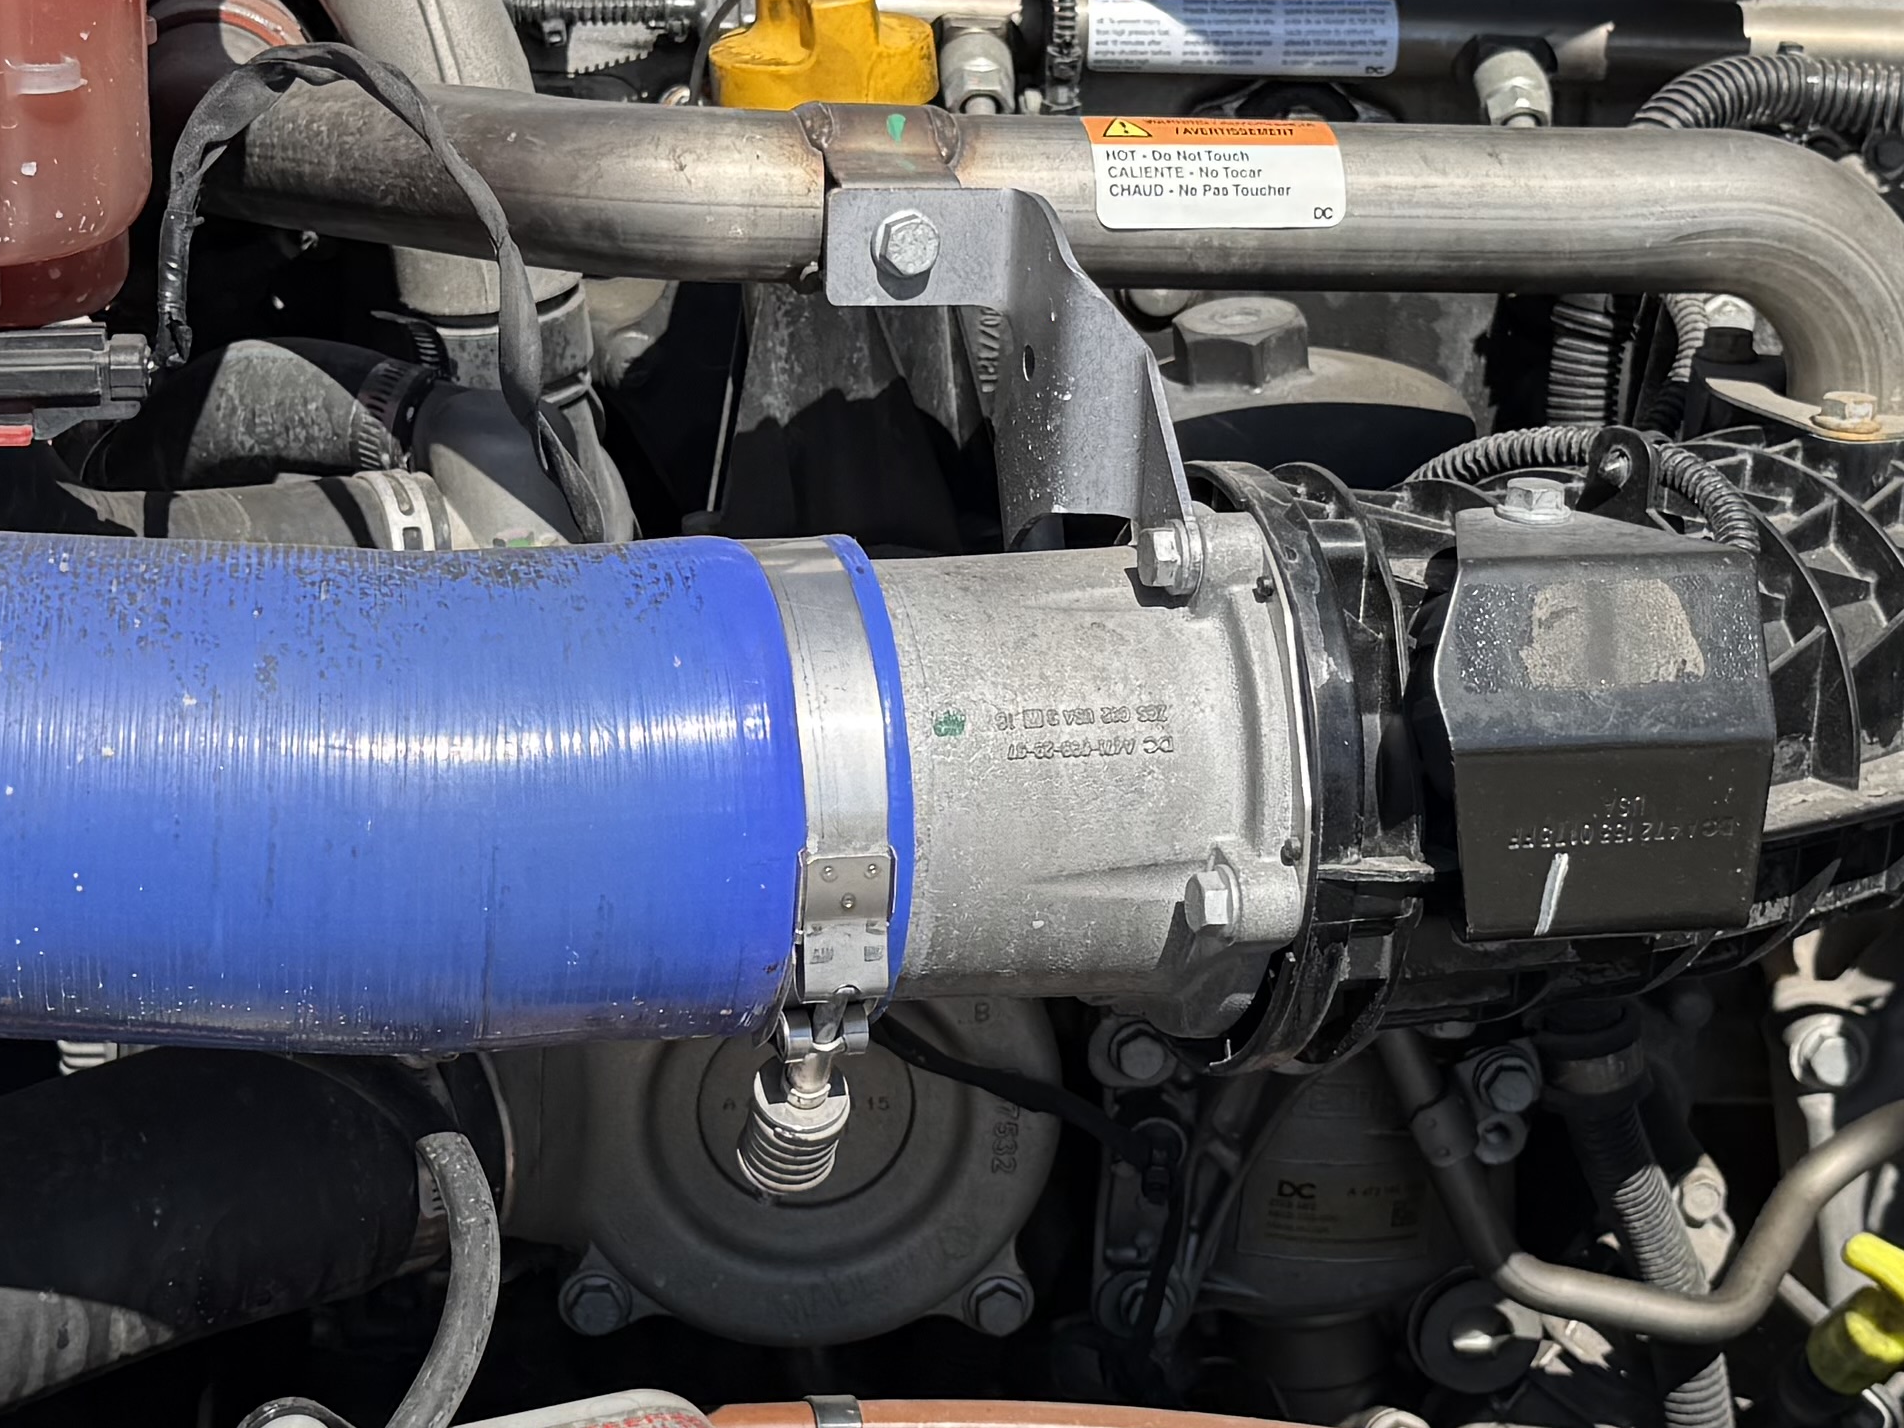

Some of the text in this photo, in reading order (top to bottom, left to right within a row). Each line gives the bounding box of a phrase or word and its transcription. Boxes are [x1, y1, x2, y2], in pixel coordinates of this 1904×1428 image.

[1105, 150, 1250, 162] HOT Do Not Touch
[1108, 166, 1262, 179] CALIENTE No Tocar
[1109, 184, 1164, 197] CHAUD
[1232, 184, 1292, 197] Toucher
[1313, 206, 1334, 220] DC
[1277, 1179, 1317, 1200] DC
